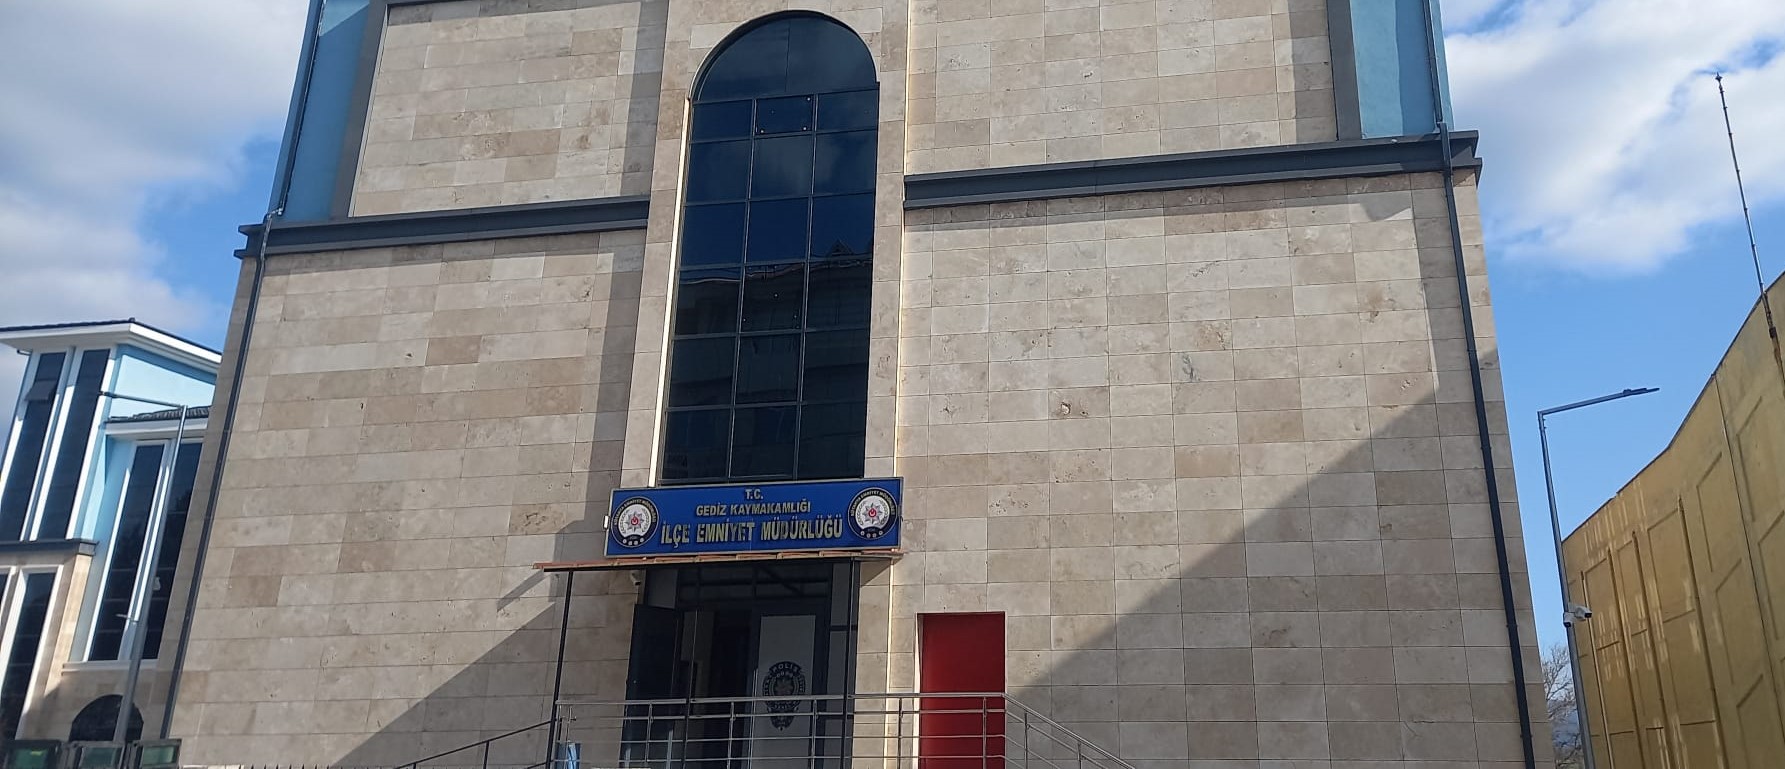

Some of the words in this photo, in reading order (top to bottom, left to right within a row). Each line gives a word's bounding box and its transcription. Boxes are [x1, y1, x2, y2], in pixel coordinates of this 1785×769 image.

[745, 489, 763, 499] T.C.
[696, 502, 727, 516] GEDİZ
[730, 499, 811, 516] KAYMAKAMLIĞI
[661, 521, 690, 548] İLÇE
[696, 518, 755, 543] EMNİYET
[761, 514, 843, 541] MÜDÜRLÜĞÜ
